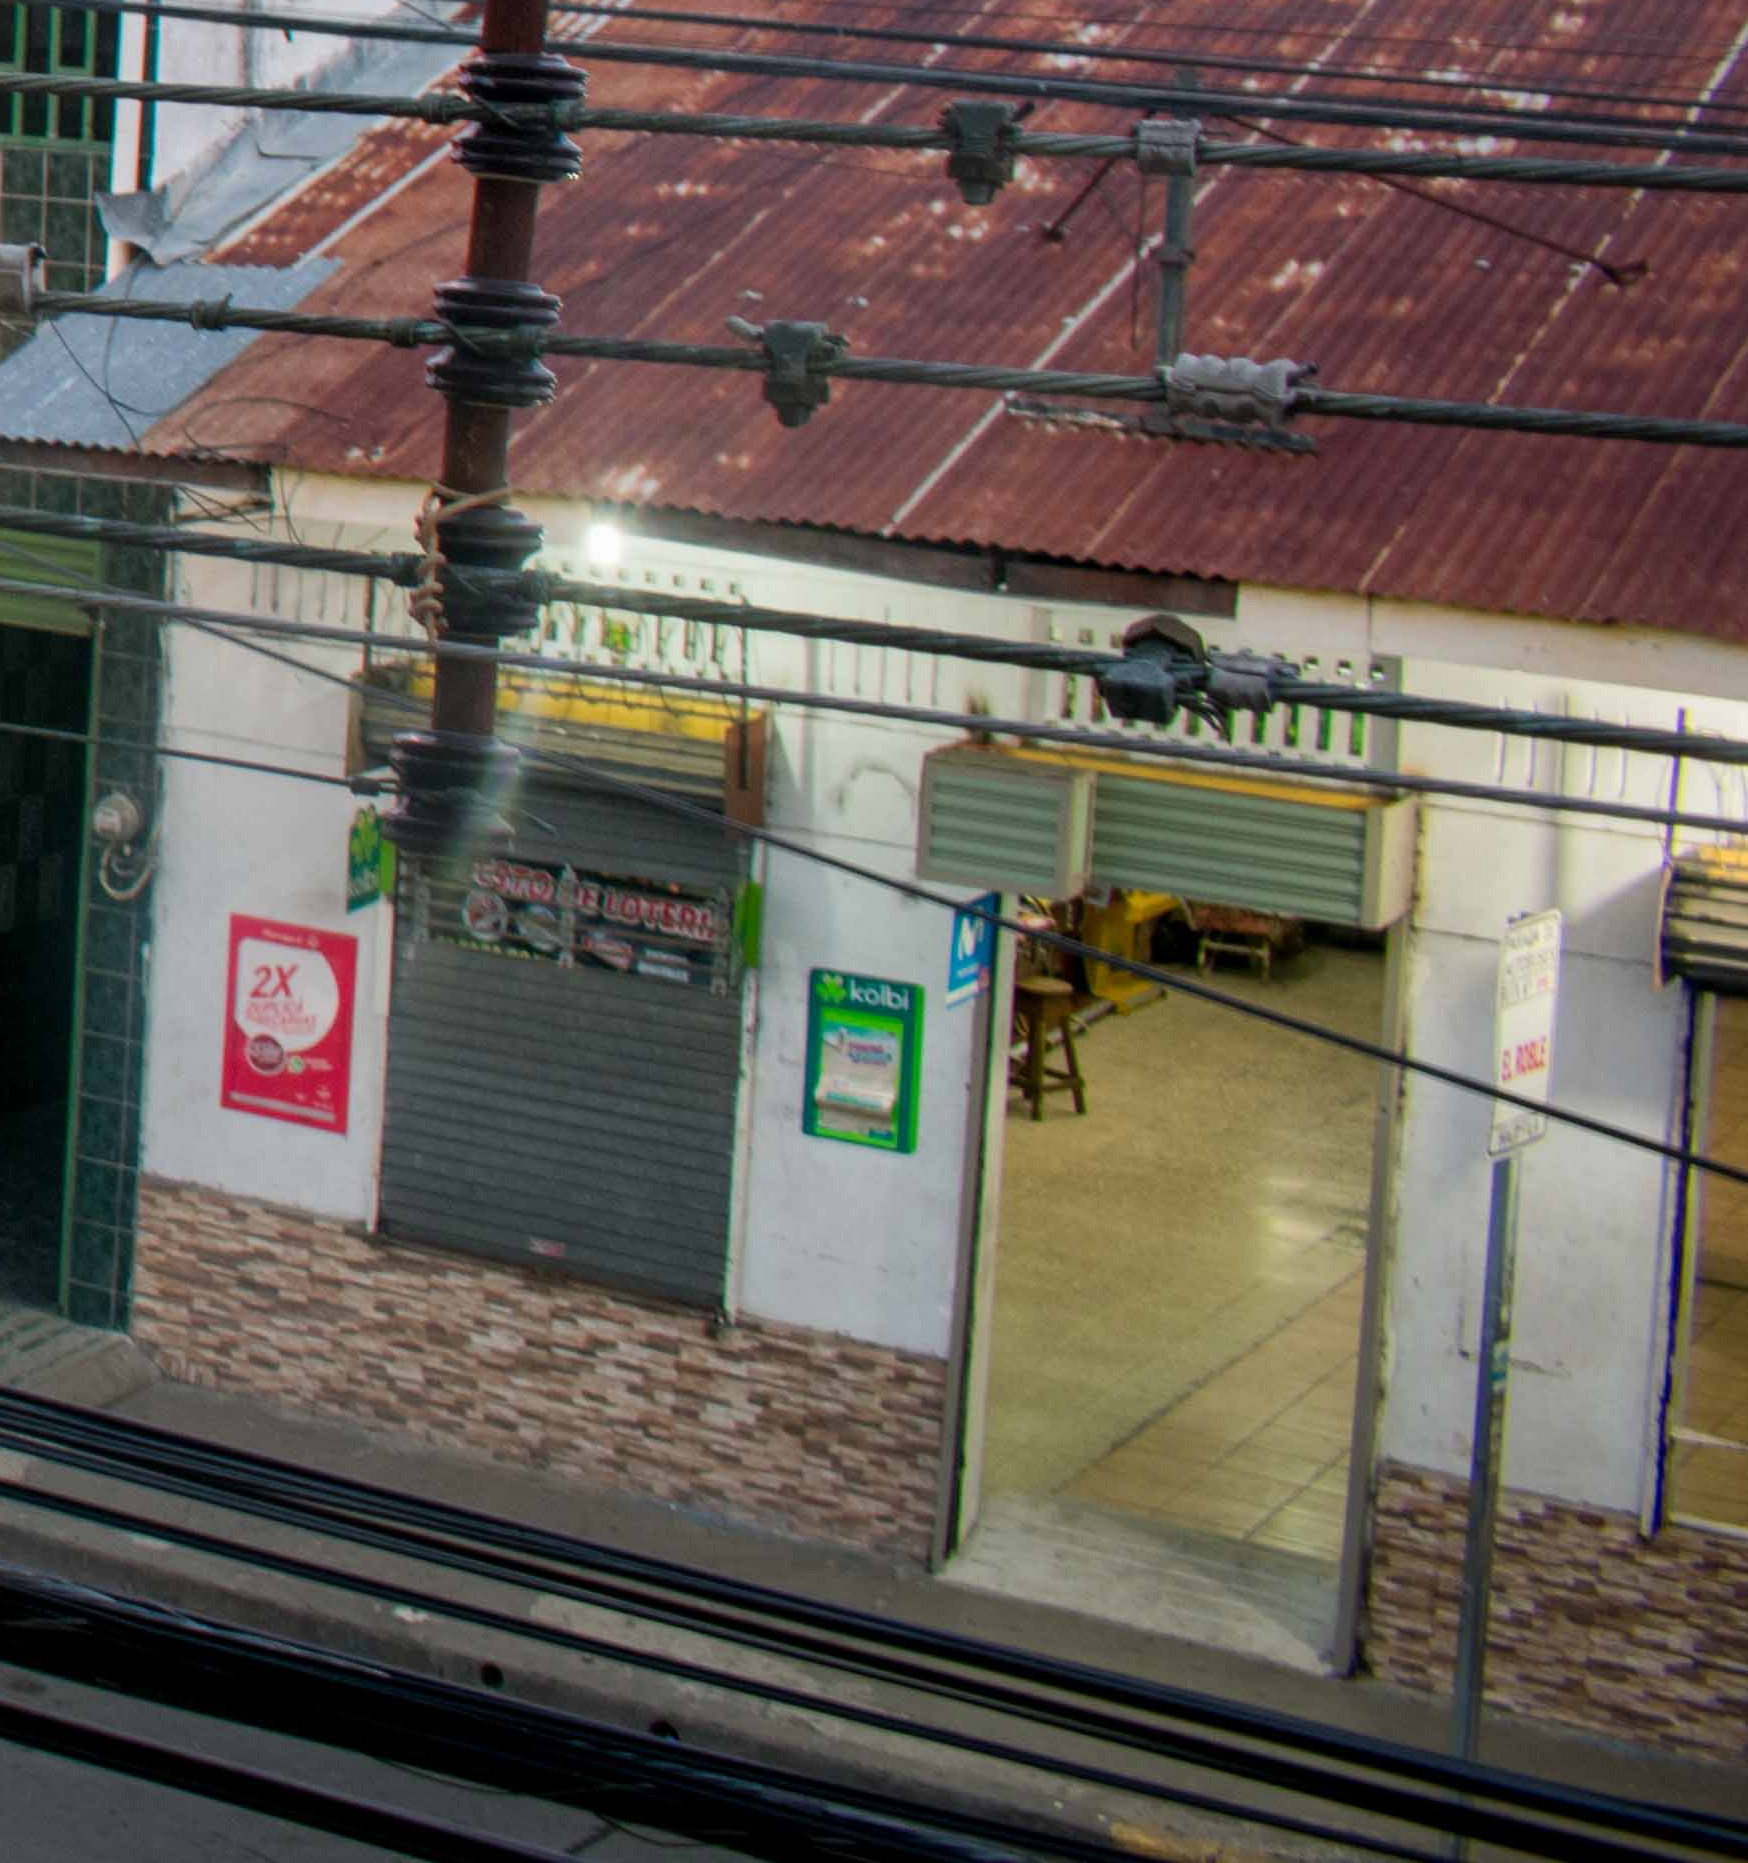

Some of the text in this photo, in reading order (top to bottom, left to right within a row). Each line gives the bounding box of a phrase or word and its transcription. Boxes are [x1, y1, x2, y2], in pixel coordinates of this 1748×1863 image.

[250, 964, 299, 999] 2X
[1501, 1035, 1547, 1082] EL ROBLE
